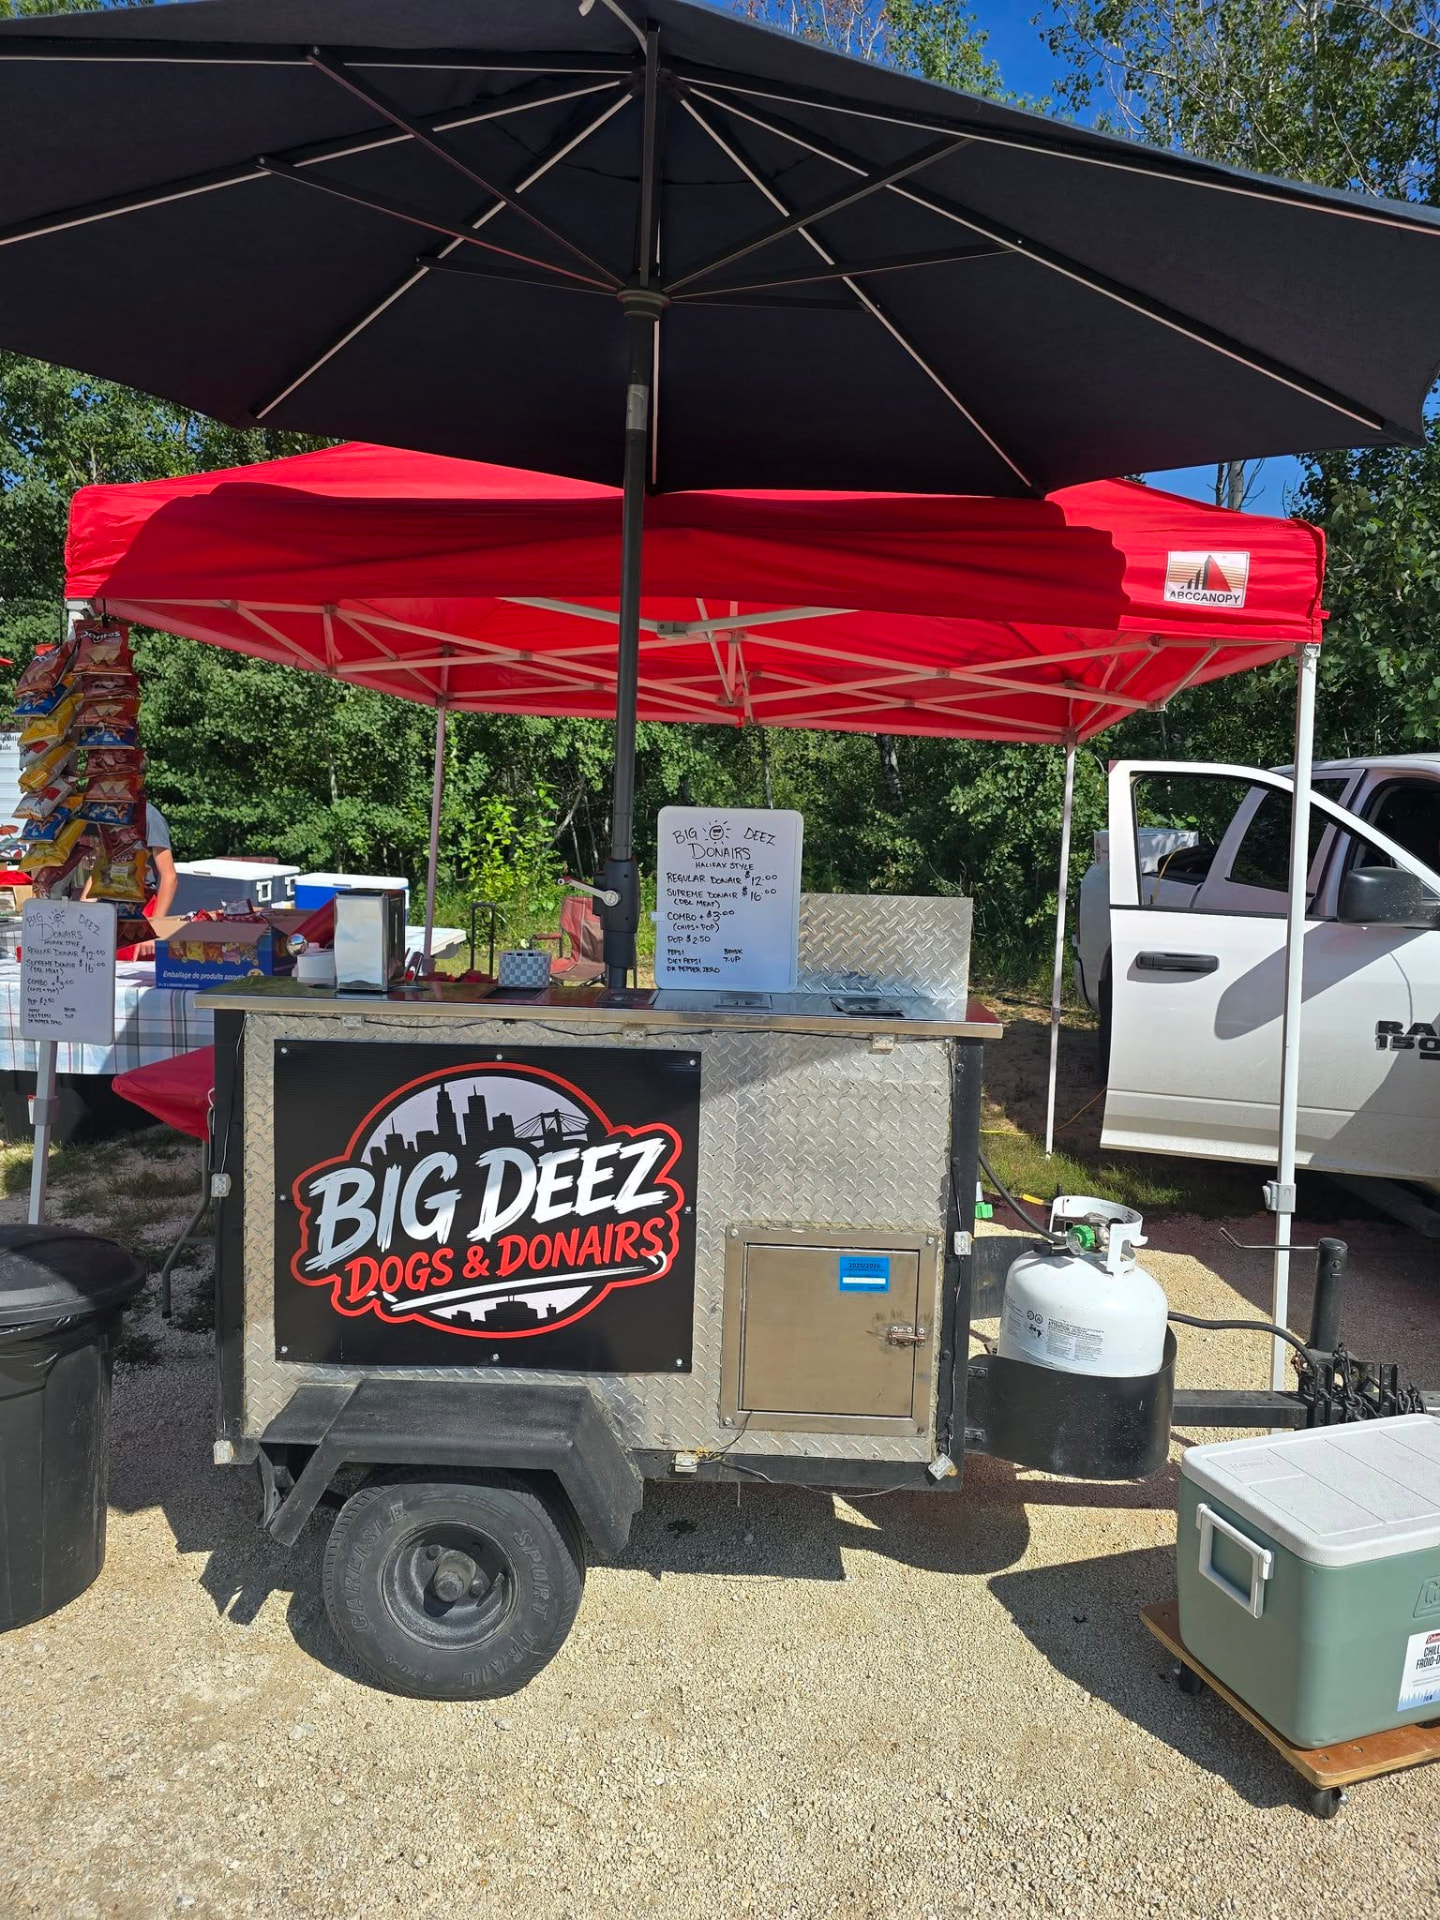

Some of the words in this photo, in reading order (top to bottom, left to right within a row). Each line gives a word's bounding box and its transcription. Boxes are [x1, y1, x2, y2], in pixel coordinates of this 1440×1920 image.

[1169, 590, 1241, 603] ABCCANOPY
[672, 827, 698, 844] BIG
[743, 827, 776, 846] DEEZ
[688, 843, 751, 860] DONAIRS
[695, 861, 727, 869] HALIFAX
[729, 862, 754, 871] STYLE
[666, 872, 706, 883] REGULAR
[710, 876, 742, 885] DONAIR
[666, 888, 704, 898] SUPREME
[706, 891, 738, 899] DONAIR
[26, 912, 43, 927] BIG
[79, 913, 100, 936] DEEZ
[667, 911, 697, 921] COMBO
[37, 923, 83, 941] DONAIRS
[686, 934, 711, 944] $2.50
[163, 970, 191, 979] Emballage
[1375, 1020, 1440, 1036] RA
[1375, 1034, 1440, 1052] 150
[305, 1151, 462, 1273] BIG
[466, 1137, 670, 1242] DEEZ
[344, 1247, 454, 1303] DOGS
[462, 1245, 490, 1279] &
[495, 1217, 665, 1277] DONAIRS
[343, 1501, 409, 1635] CARLISLE
[513, 1529, 551, 1622] SPORT
[460, 1629, 542, 1690] TRAIL
